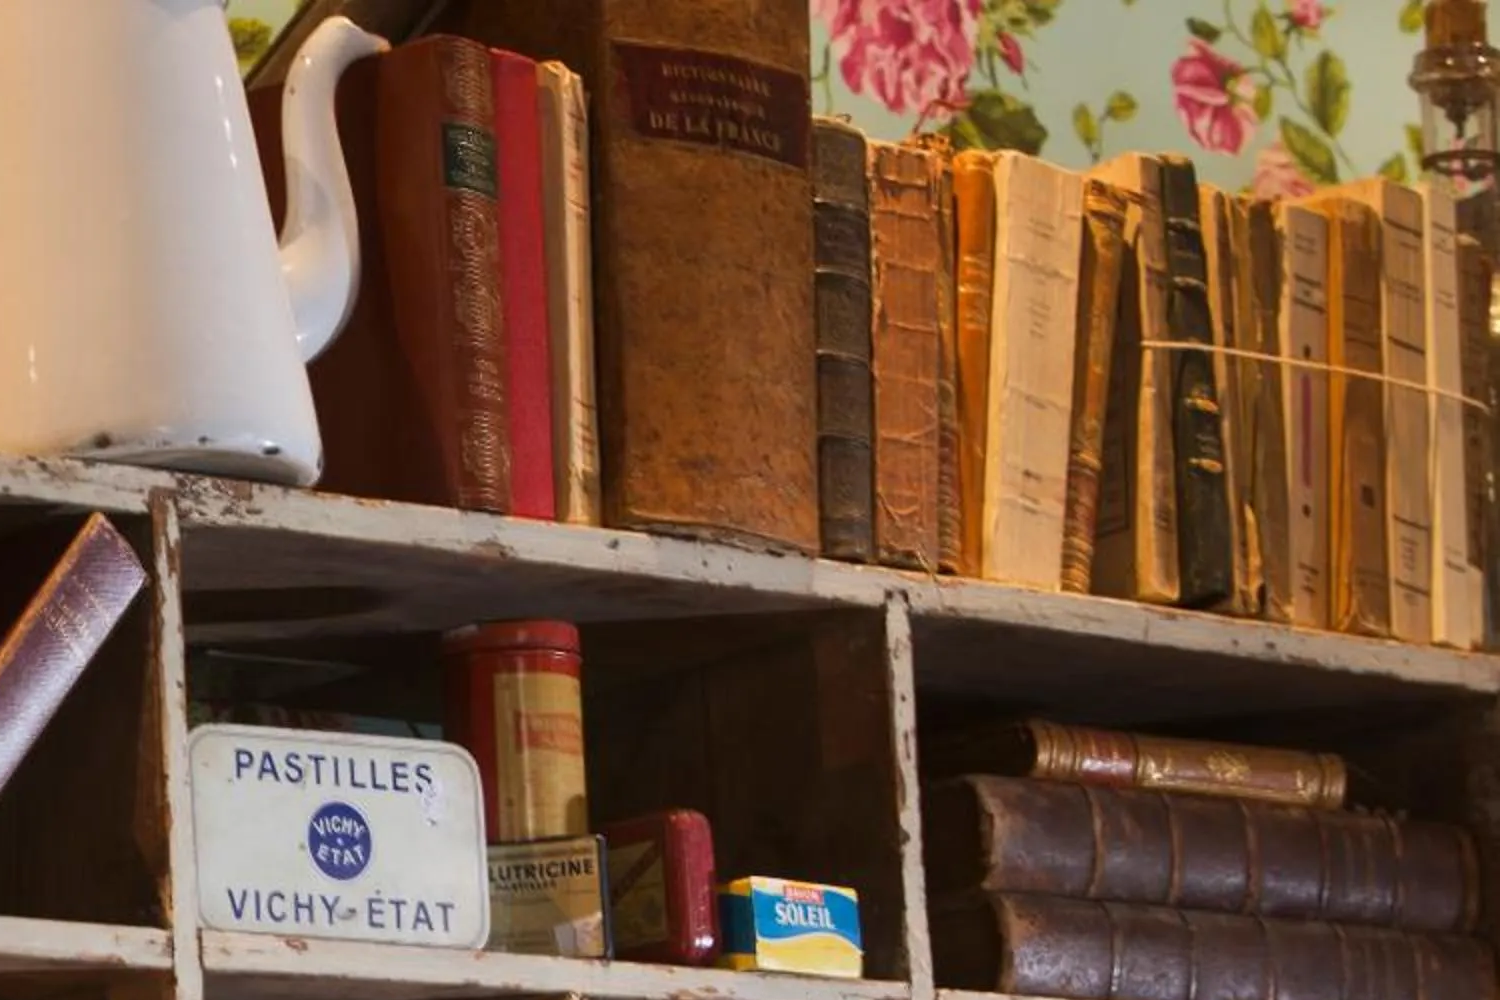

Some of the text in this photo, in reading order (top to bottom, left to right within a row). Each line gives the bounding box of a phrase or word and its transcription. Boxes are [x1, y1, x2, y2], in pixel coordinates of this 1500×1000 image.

[235, 749, 434, 793] PASTILLES
[311, 815, 365, 839] VICHY
[317, 842, 364, 866] ETAT
[488, 858, 594, 882] LUTRICINE
[775, 901, 836, 930] SOLEIL
